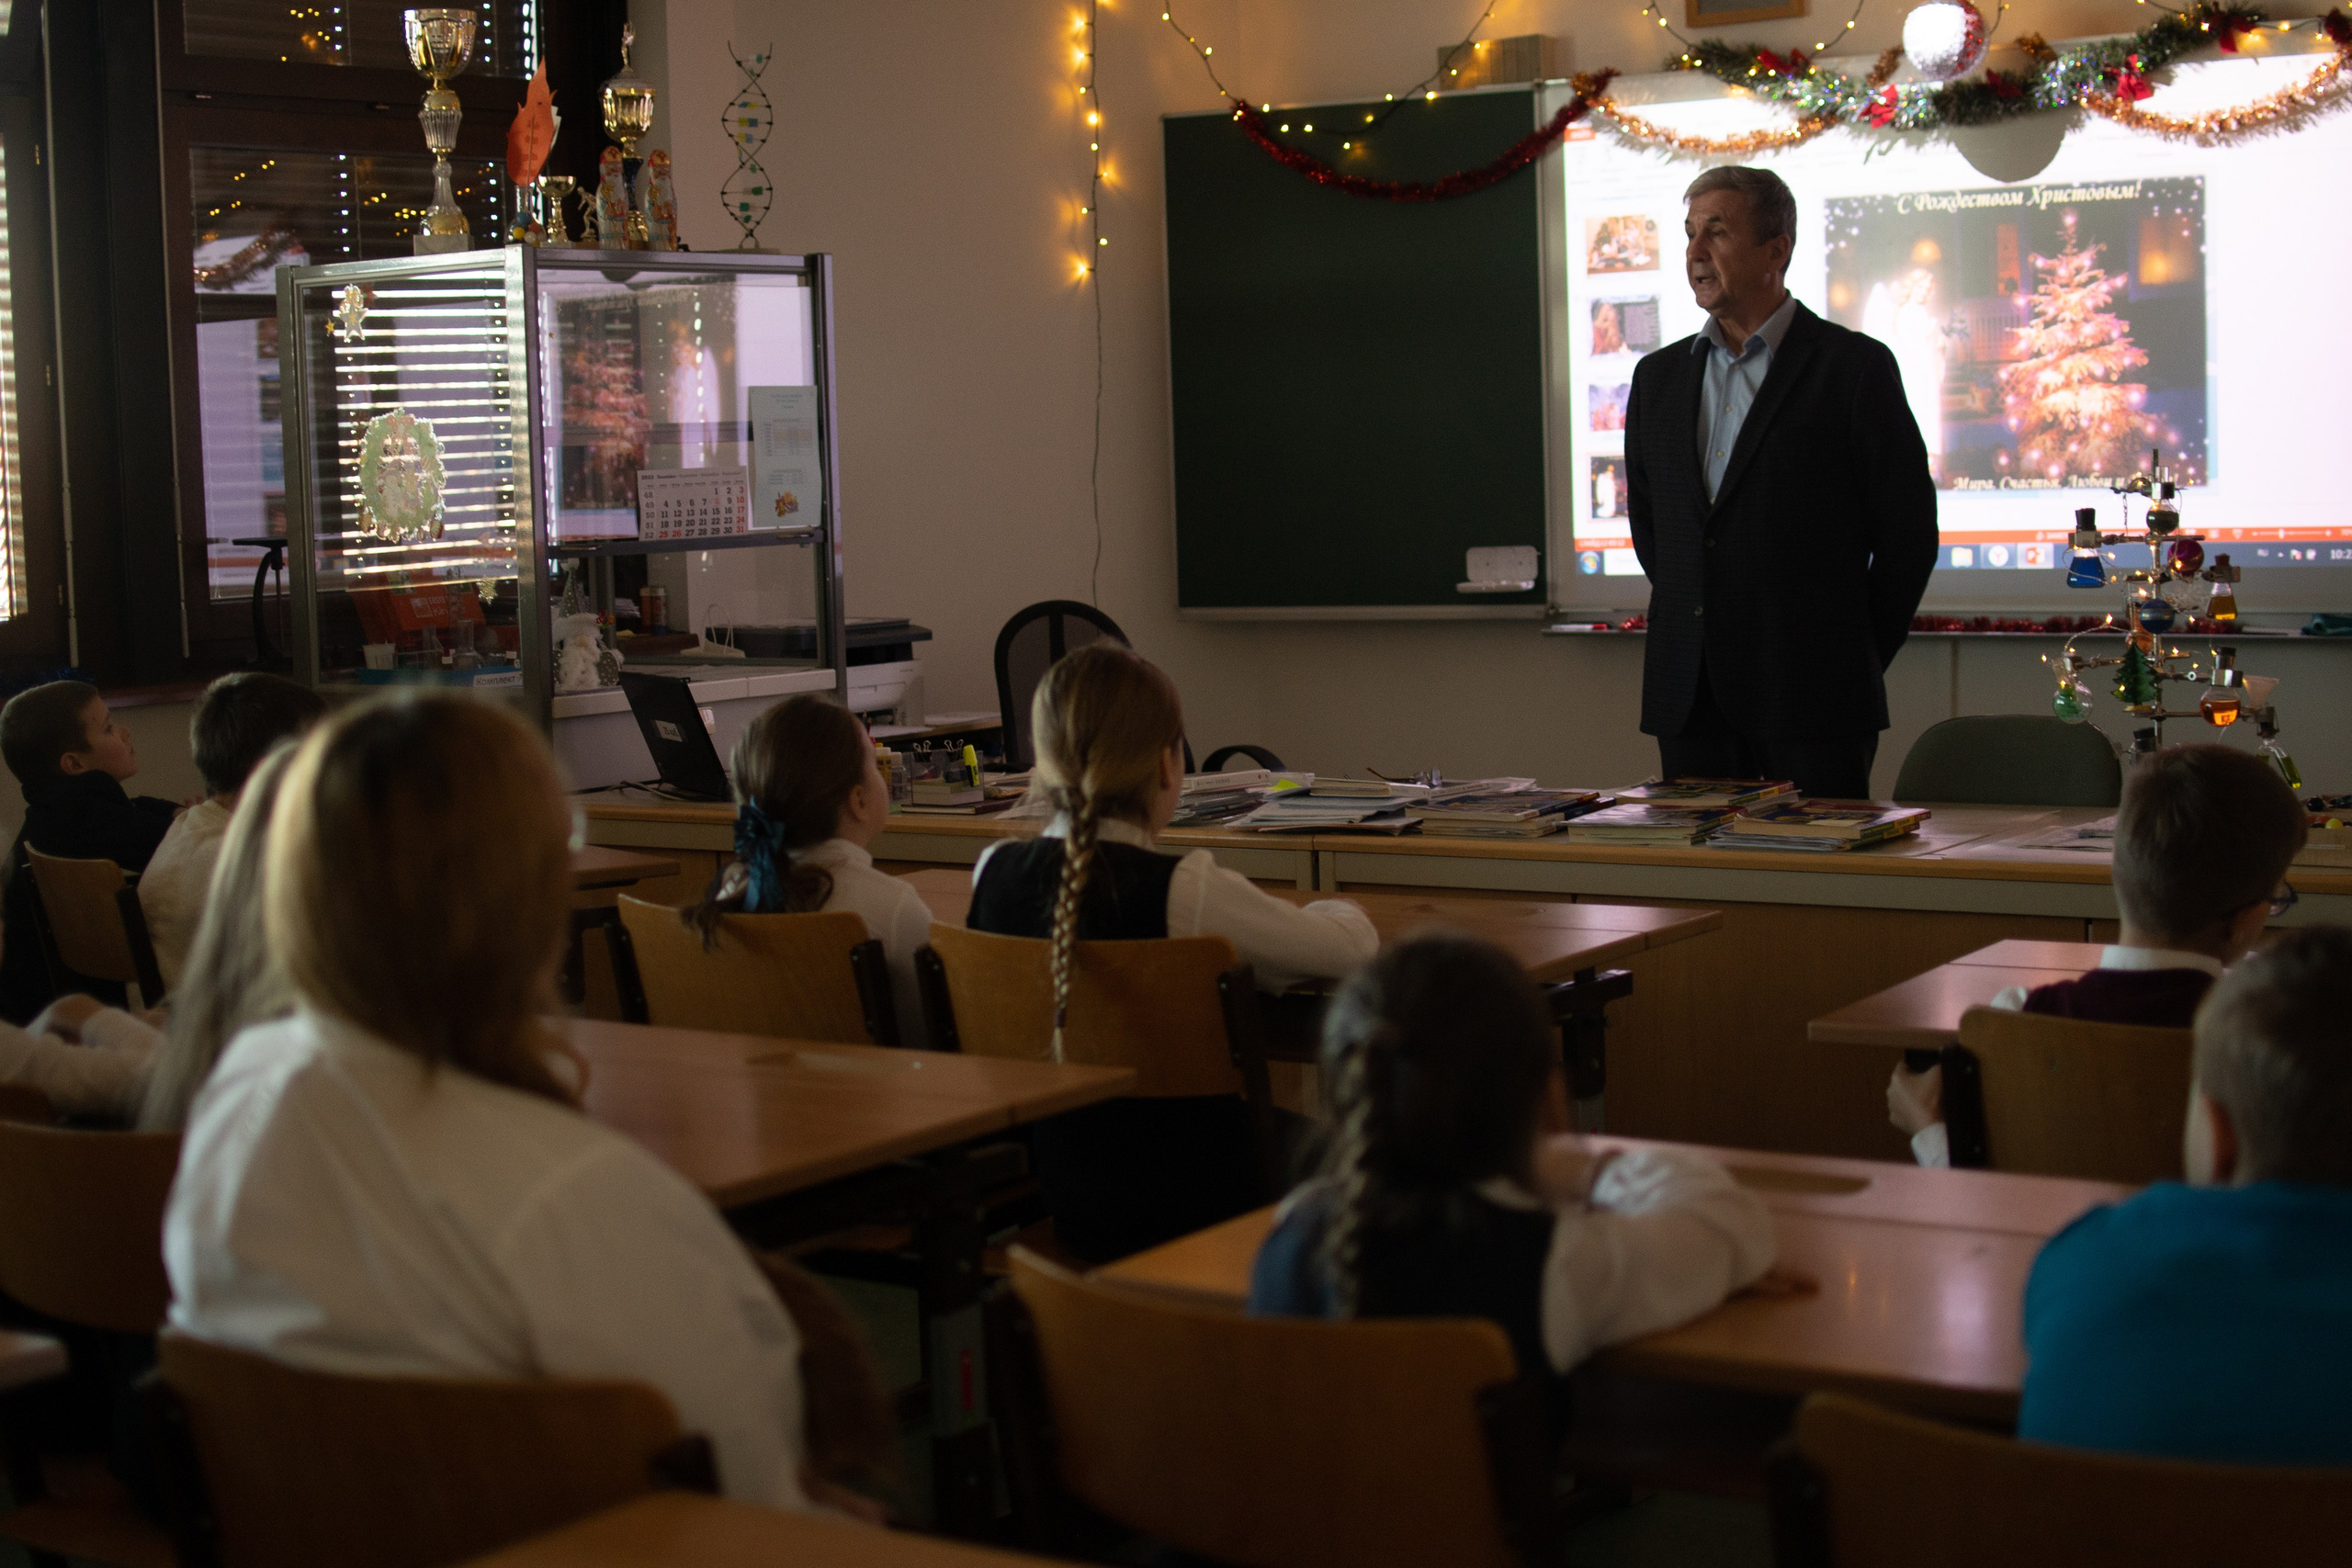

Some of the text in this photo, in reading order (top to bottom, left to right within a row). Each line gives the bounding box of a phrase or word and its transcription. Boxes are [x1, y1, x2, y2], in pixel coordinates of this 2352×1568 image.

[1897, 178, 2144, 215] С Рождеством Христовым!
[687, 509, 695, 517] 13
[712, 507, 720, 515] 15
[685, 519, 695, 527] 20
[698, 518, 707, 526] 21
[711, 517, 720, 525] 22
[723, 516, 732, 525] 23
[658, 530, 669, 538] 25
[672, 529, 682, 537] 26
[711, 527, 720, 536] 29
[723, 526, 732, 535] 30
[736, 525, 744, 534] 31
[2331, 549, 2352, 560] 10:2
[476, 676, 516, 686] Комплект
